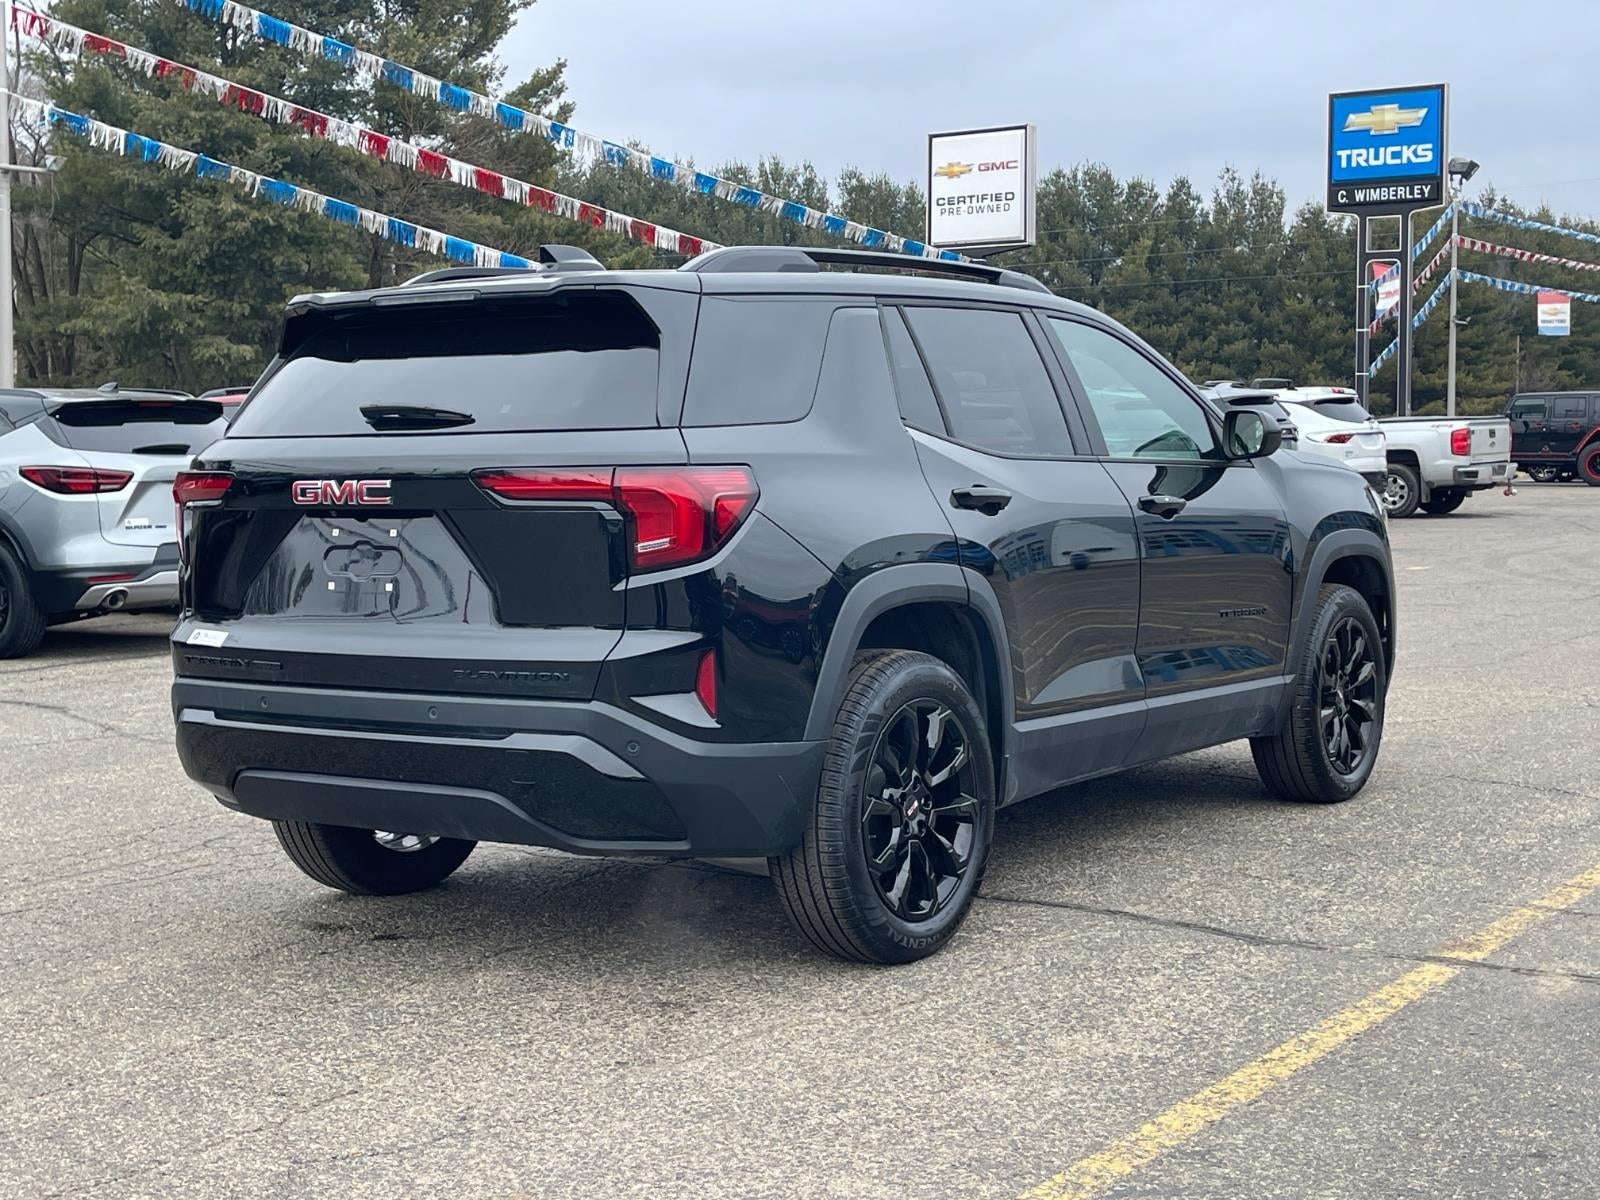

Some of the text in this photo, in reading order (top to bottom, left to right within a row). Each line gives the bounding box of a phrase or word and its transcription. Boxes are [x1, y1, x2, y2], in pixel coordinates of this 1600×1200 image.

[1337, 143, 1433, 169] TRUCKS
[978, 160, 1018, 172] GMC
[936, 191, 1015, 206] CERTIFIED
[1338, 184, 1431, 203] C. WIMBERLEY
[940, 202, 1010, 216] PRE-OWNED
[292, 479, 393, 505] GMC
